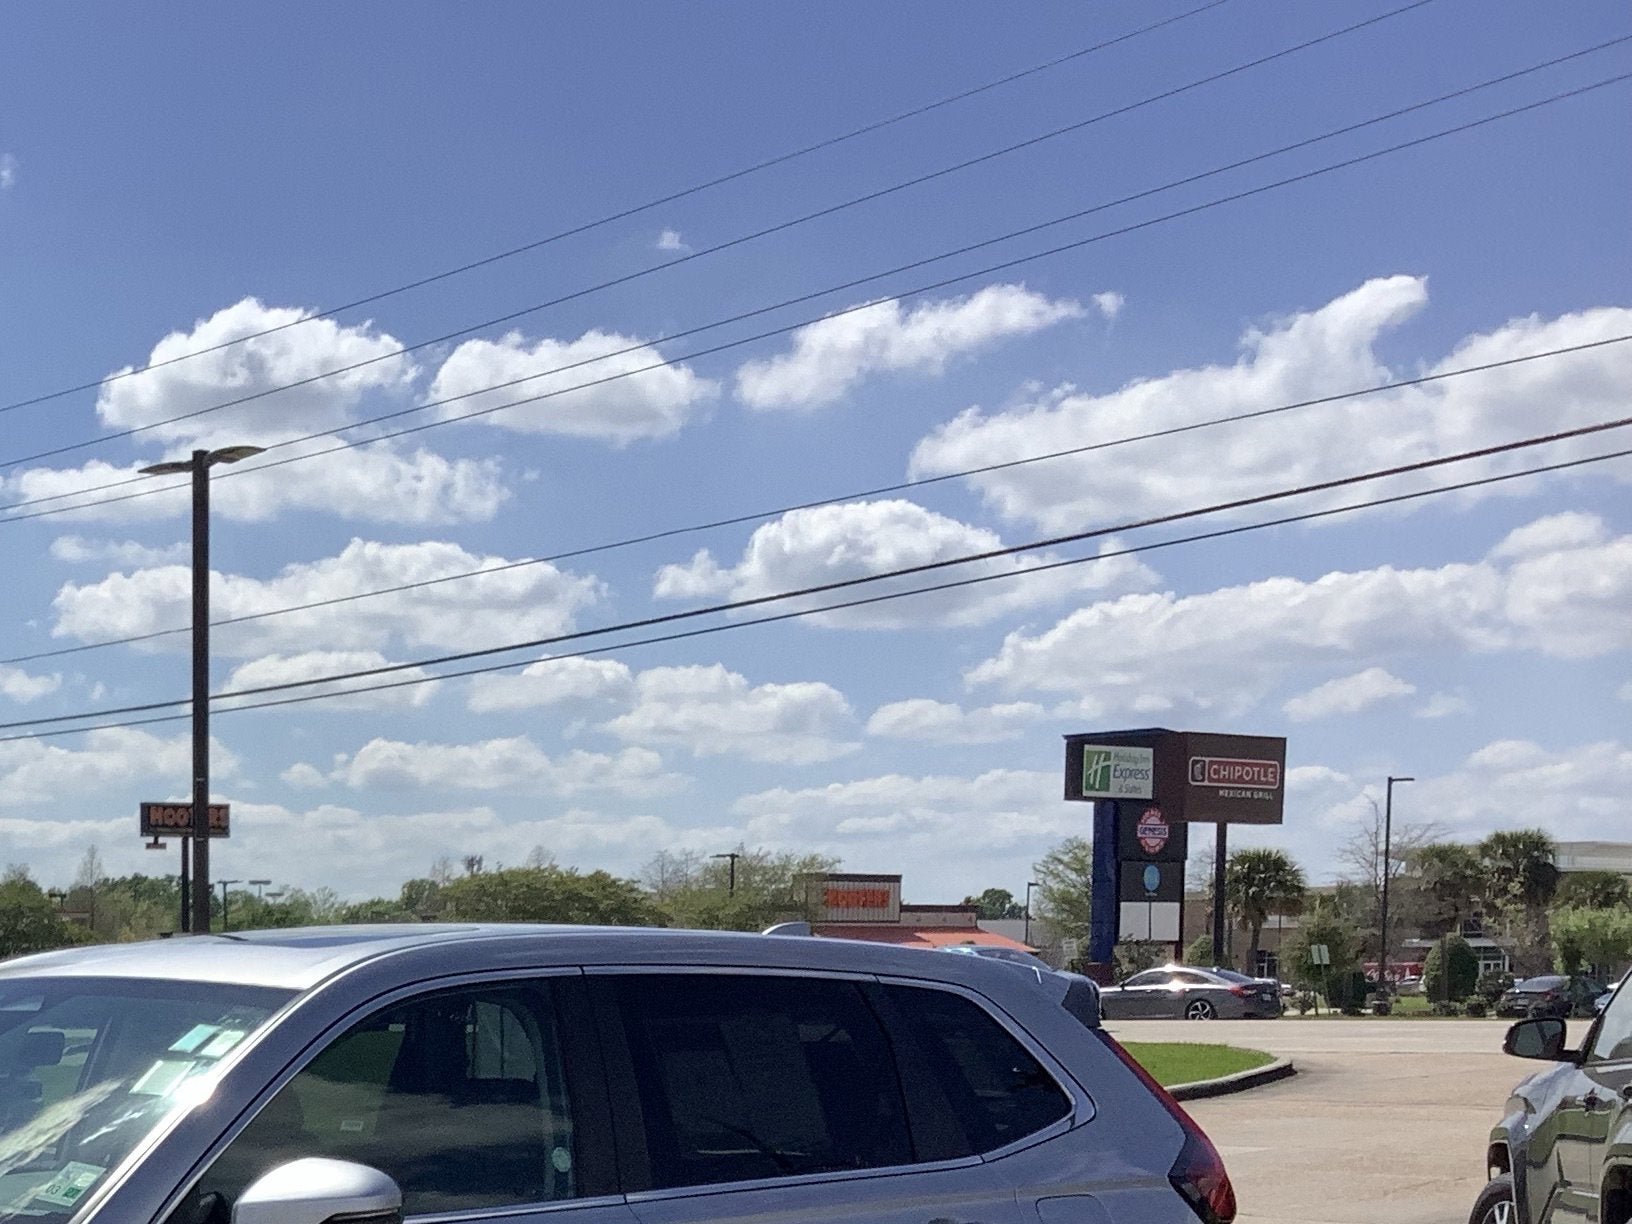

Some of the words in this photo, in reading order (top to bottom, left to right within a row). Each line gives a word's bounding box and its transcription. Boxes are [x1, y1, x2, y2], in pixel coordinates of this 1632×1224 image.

[1113, 764, 1151, 782] Express
[1210, 765, 1276, 782] CHIPOTLE
[1219, 789, 1252, 798] MEXICAN
[1253, 791, 1273, 800] GRILL
[45, 1184, 62, 1195] 03
